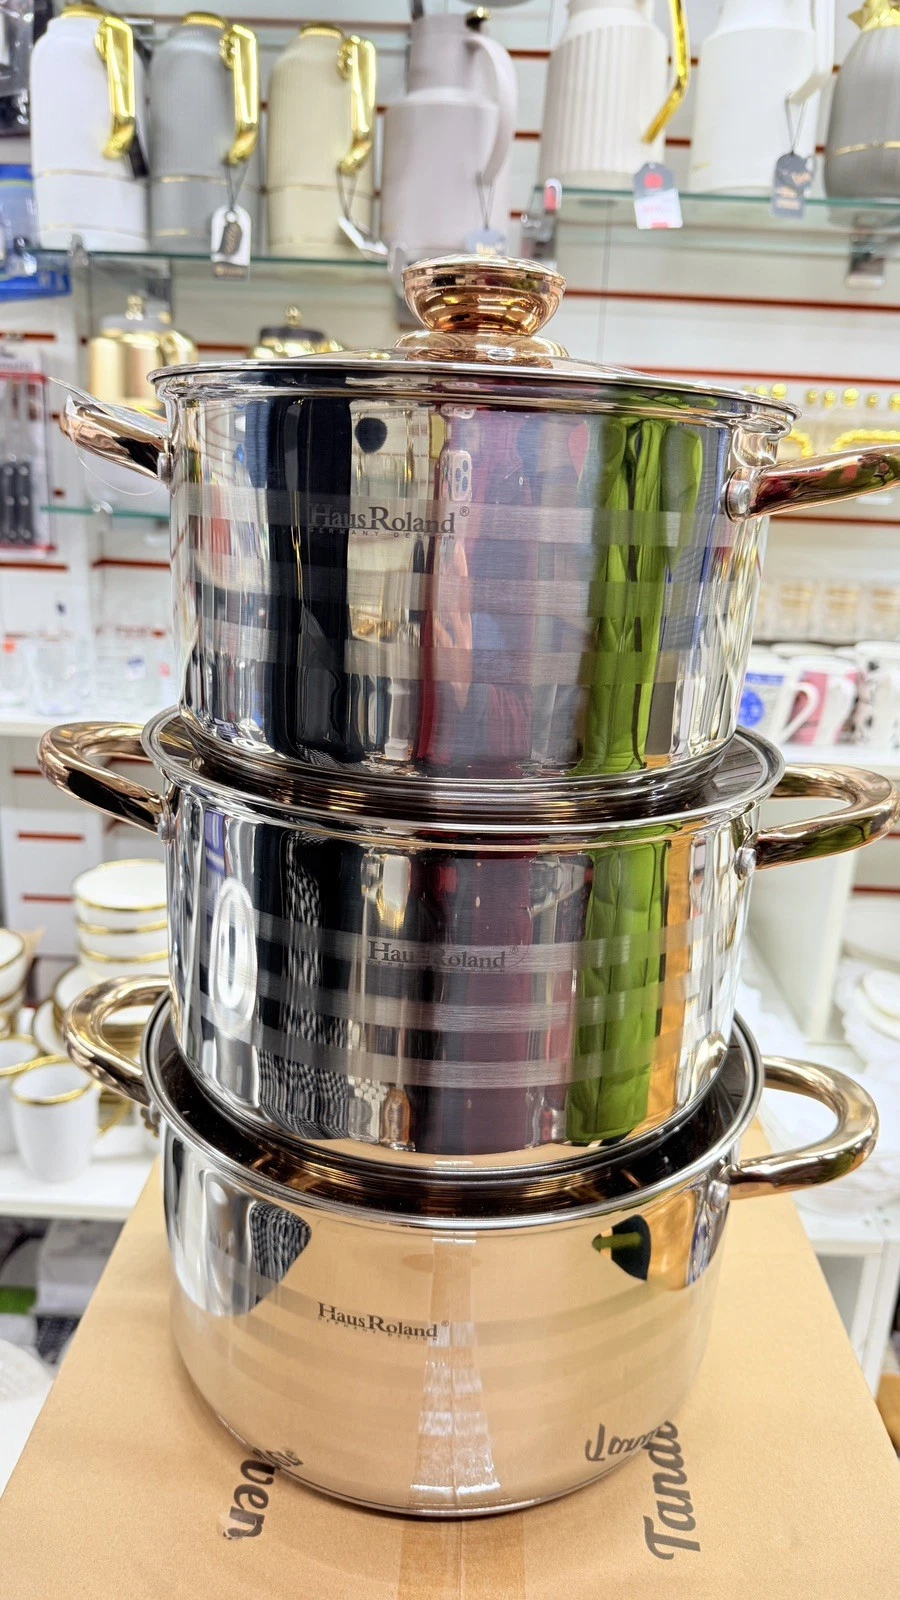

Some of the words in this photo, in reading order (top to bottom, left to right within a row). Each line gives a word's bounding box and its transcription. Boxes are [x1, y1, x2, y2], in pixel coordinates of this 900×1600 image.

[308, 503, 455, 533] HausRoland
[393, 531, 455, 541] DESN
[368, 940, 505, 968] HauRoland
[317, 1302, 438, 1338] HausRoland
